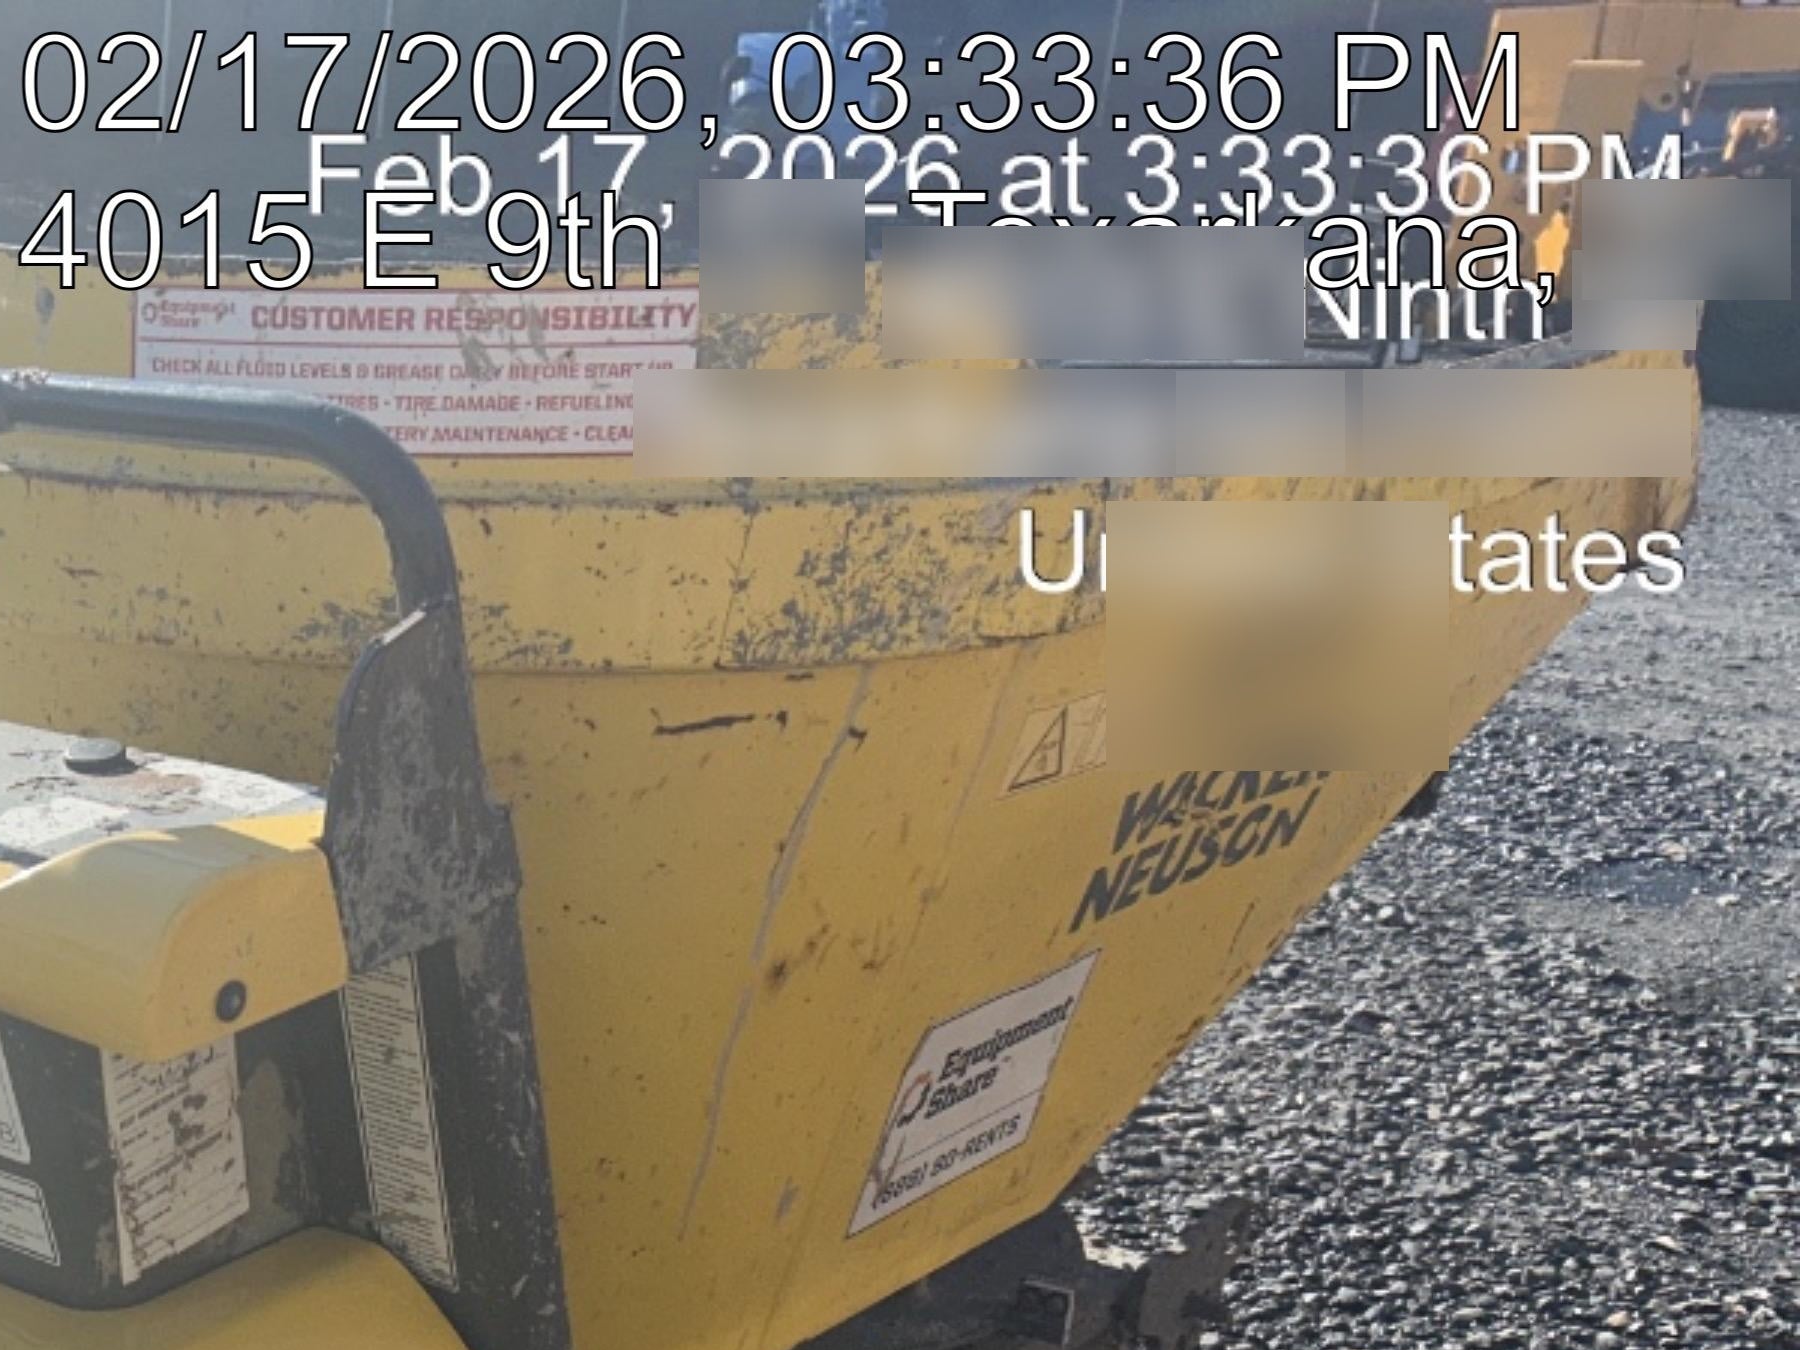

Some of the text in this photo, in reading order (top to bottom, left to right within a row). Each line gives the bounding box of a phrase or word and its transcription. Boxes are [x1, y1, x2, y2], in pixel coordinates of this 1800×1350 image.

[251, 303, 698, 331] CUSTOMER RESPONSIBILITY
[152, 356, 201, 375] CHECK
[205, 359, 233, 376] ALL
[236, 358, 286, 378] FLUID
[290, 361, 352, 379] LEVELS
[374, 363, 444, 380] GREASE
[508, 361, 580, 380] BEFORE
[394, 395, 437, 412] TIRE
[442, 395, 520, 412] DAMAGE
[431, 425, 568, 443] MAINTENANCE
[1068, 786, 1321, 933] NEUSON
[938, 995, 1075, 1082] Equipment
[924, 1064, 998, 1120] Share
